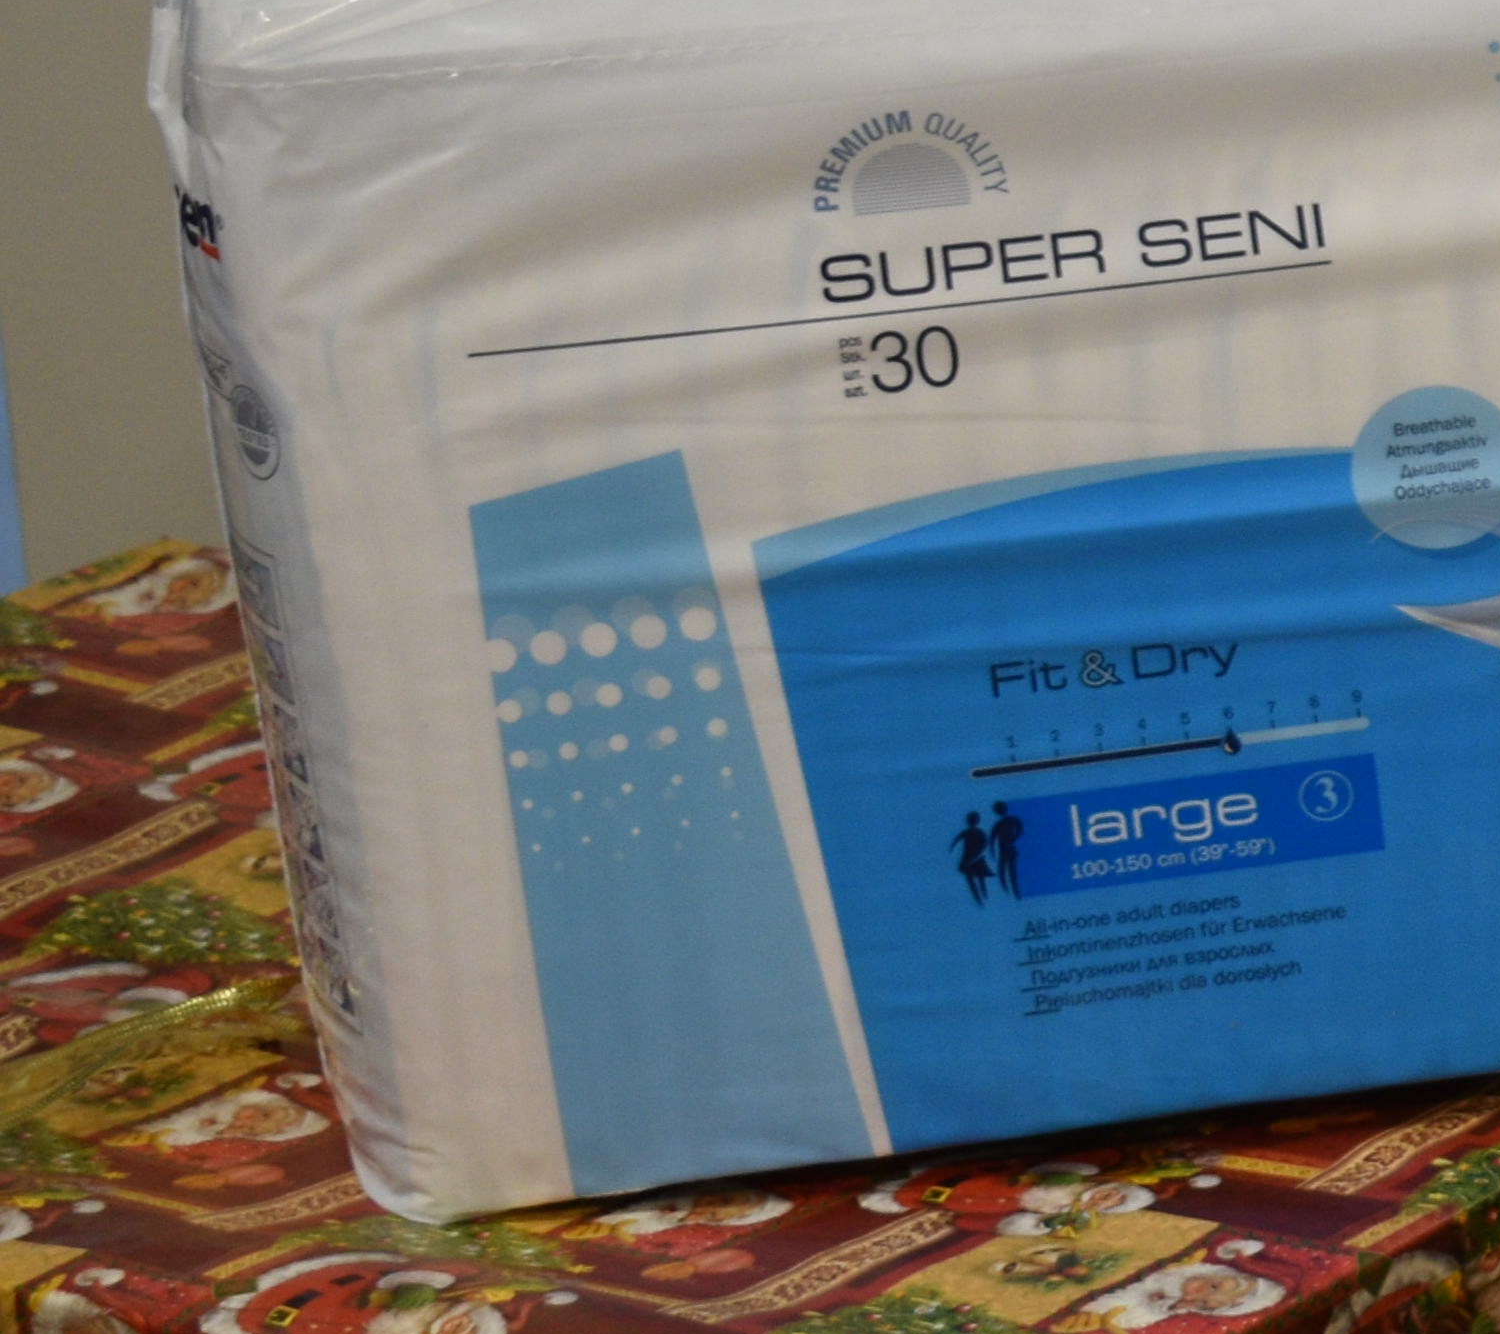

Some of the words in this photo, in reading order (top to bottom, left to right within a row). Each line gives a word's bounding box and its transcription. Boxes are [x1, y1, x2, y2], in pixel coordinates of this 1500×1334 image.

[813, 110, 913, 212] PREMIUM
[924, 113, 1010, 196] QUALITY
[819, 229, 1107, 304] SUPER
[1138, 203, 1326, 268] SENI
[870, 325, 960, 394] 30
[1386, 434, 1488, 459] Atmungsaktiv
[1393, 414, 1478, 437] Breathable
[1393, 476, 1492, 501] Oddychające
[989, 660, 1068, 699] Fit
[1081, 649, 1125, 689] &
[1131, 642, 1240, 679] Dry
[1069, 792, 1260, 847] large
[1315, 775, 1338, 815] 3
[1070, 853, 1153, 880] 100-150
[1156, 850, 1186, 868] cm
